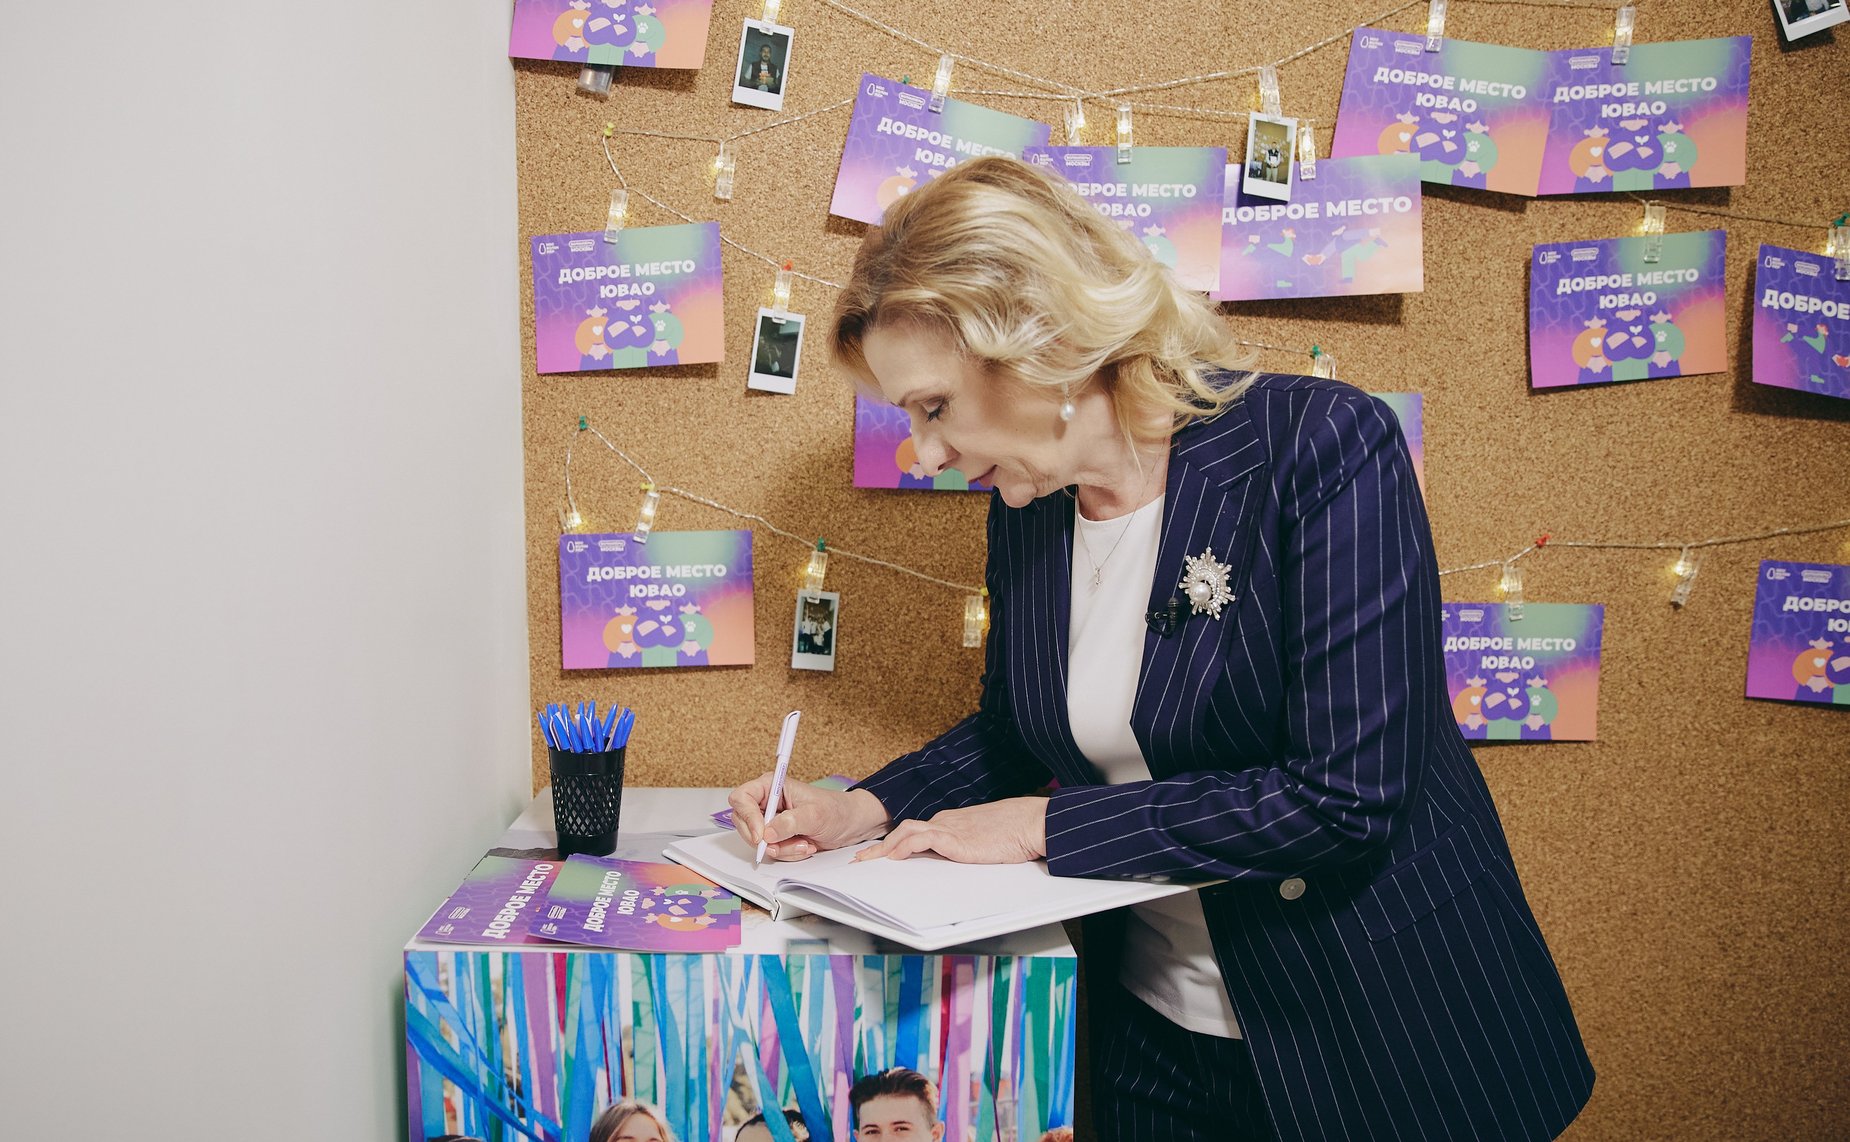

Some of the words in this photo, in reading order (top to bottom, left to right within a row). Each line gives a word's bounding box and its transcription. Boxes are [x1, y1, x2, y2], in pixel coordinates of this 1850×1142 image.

[1373, 67, 1455, 90] ДОБРОЕ
[1459, 78, 1526, 99] МЕСТО
[1553, 82, 1640, 103] ДОБРОЕ
[1645, 77, 1717, 95] МЕСТО
[1415, 92, 1477, 113] ЮВАО
[1601, 101, 1667, 118] ЮВАО
[877, 117, 953, 148] ДОБРОЕ
[915, 147, 960, 169] ЮВА
[1132, 183, 1197, 198] МЕСТО
[1222, 202, 1319, 225] ДОБРОЕ
[1326, 196, 1412, 218] МЕСТО
[558, 264, 631, 285] ДОБРОЕ
[635, 259, 696, 277] МЕСТО
[1556, 273, 1632, 295] ДОБРОЕ
[1636, 268, 1699, 286] МЕСТО
[600, 282, 655, 298] ЮВАО
[1599, 291, 1657, 309] ЮВАО
[1762, 289, 1850, 320] ДОБРОЕ
[586, 566, 661, 582] ДОБРОЕ
[666, 564, 727, 578] МЕСТО
[629, 584, 686, 597] ЮВАО
[1444, 637, 1513, 652] ДОБРОЕ
[1517, 638, 1577, 651] МЕСТО
[1481, 656, 1535, 669] ЮВАО
[597, 871, 622, 897] МЕСТО
[481, 894, 532, 939] ДОБРОЕ
[516, 863, 554, 899] МЕСТО
[583, 896, 612, 932] ДОБРОЕ
[616, 889, 640, 915] ЮВАО
